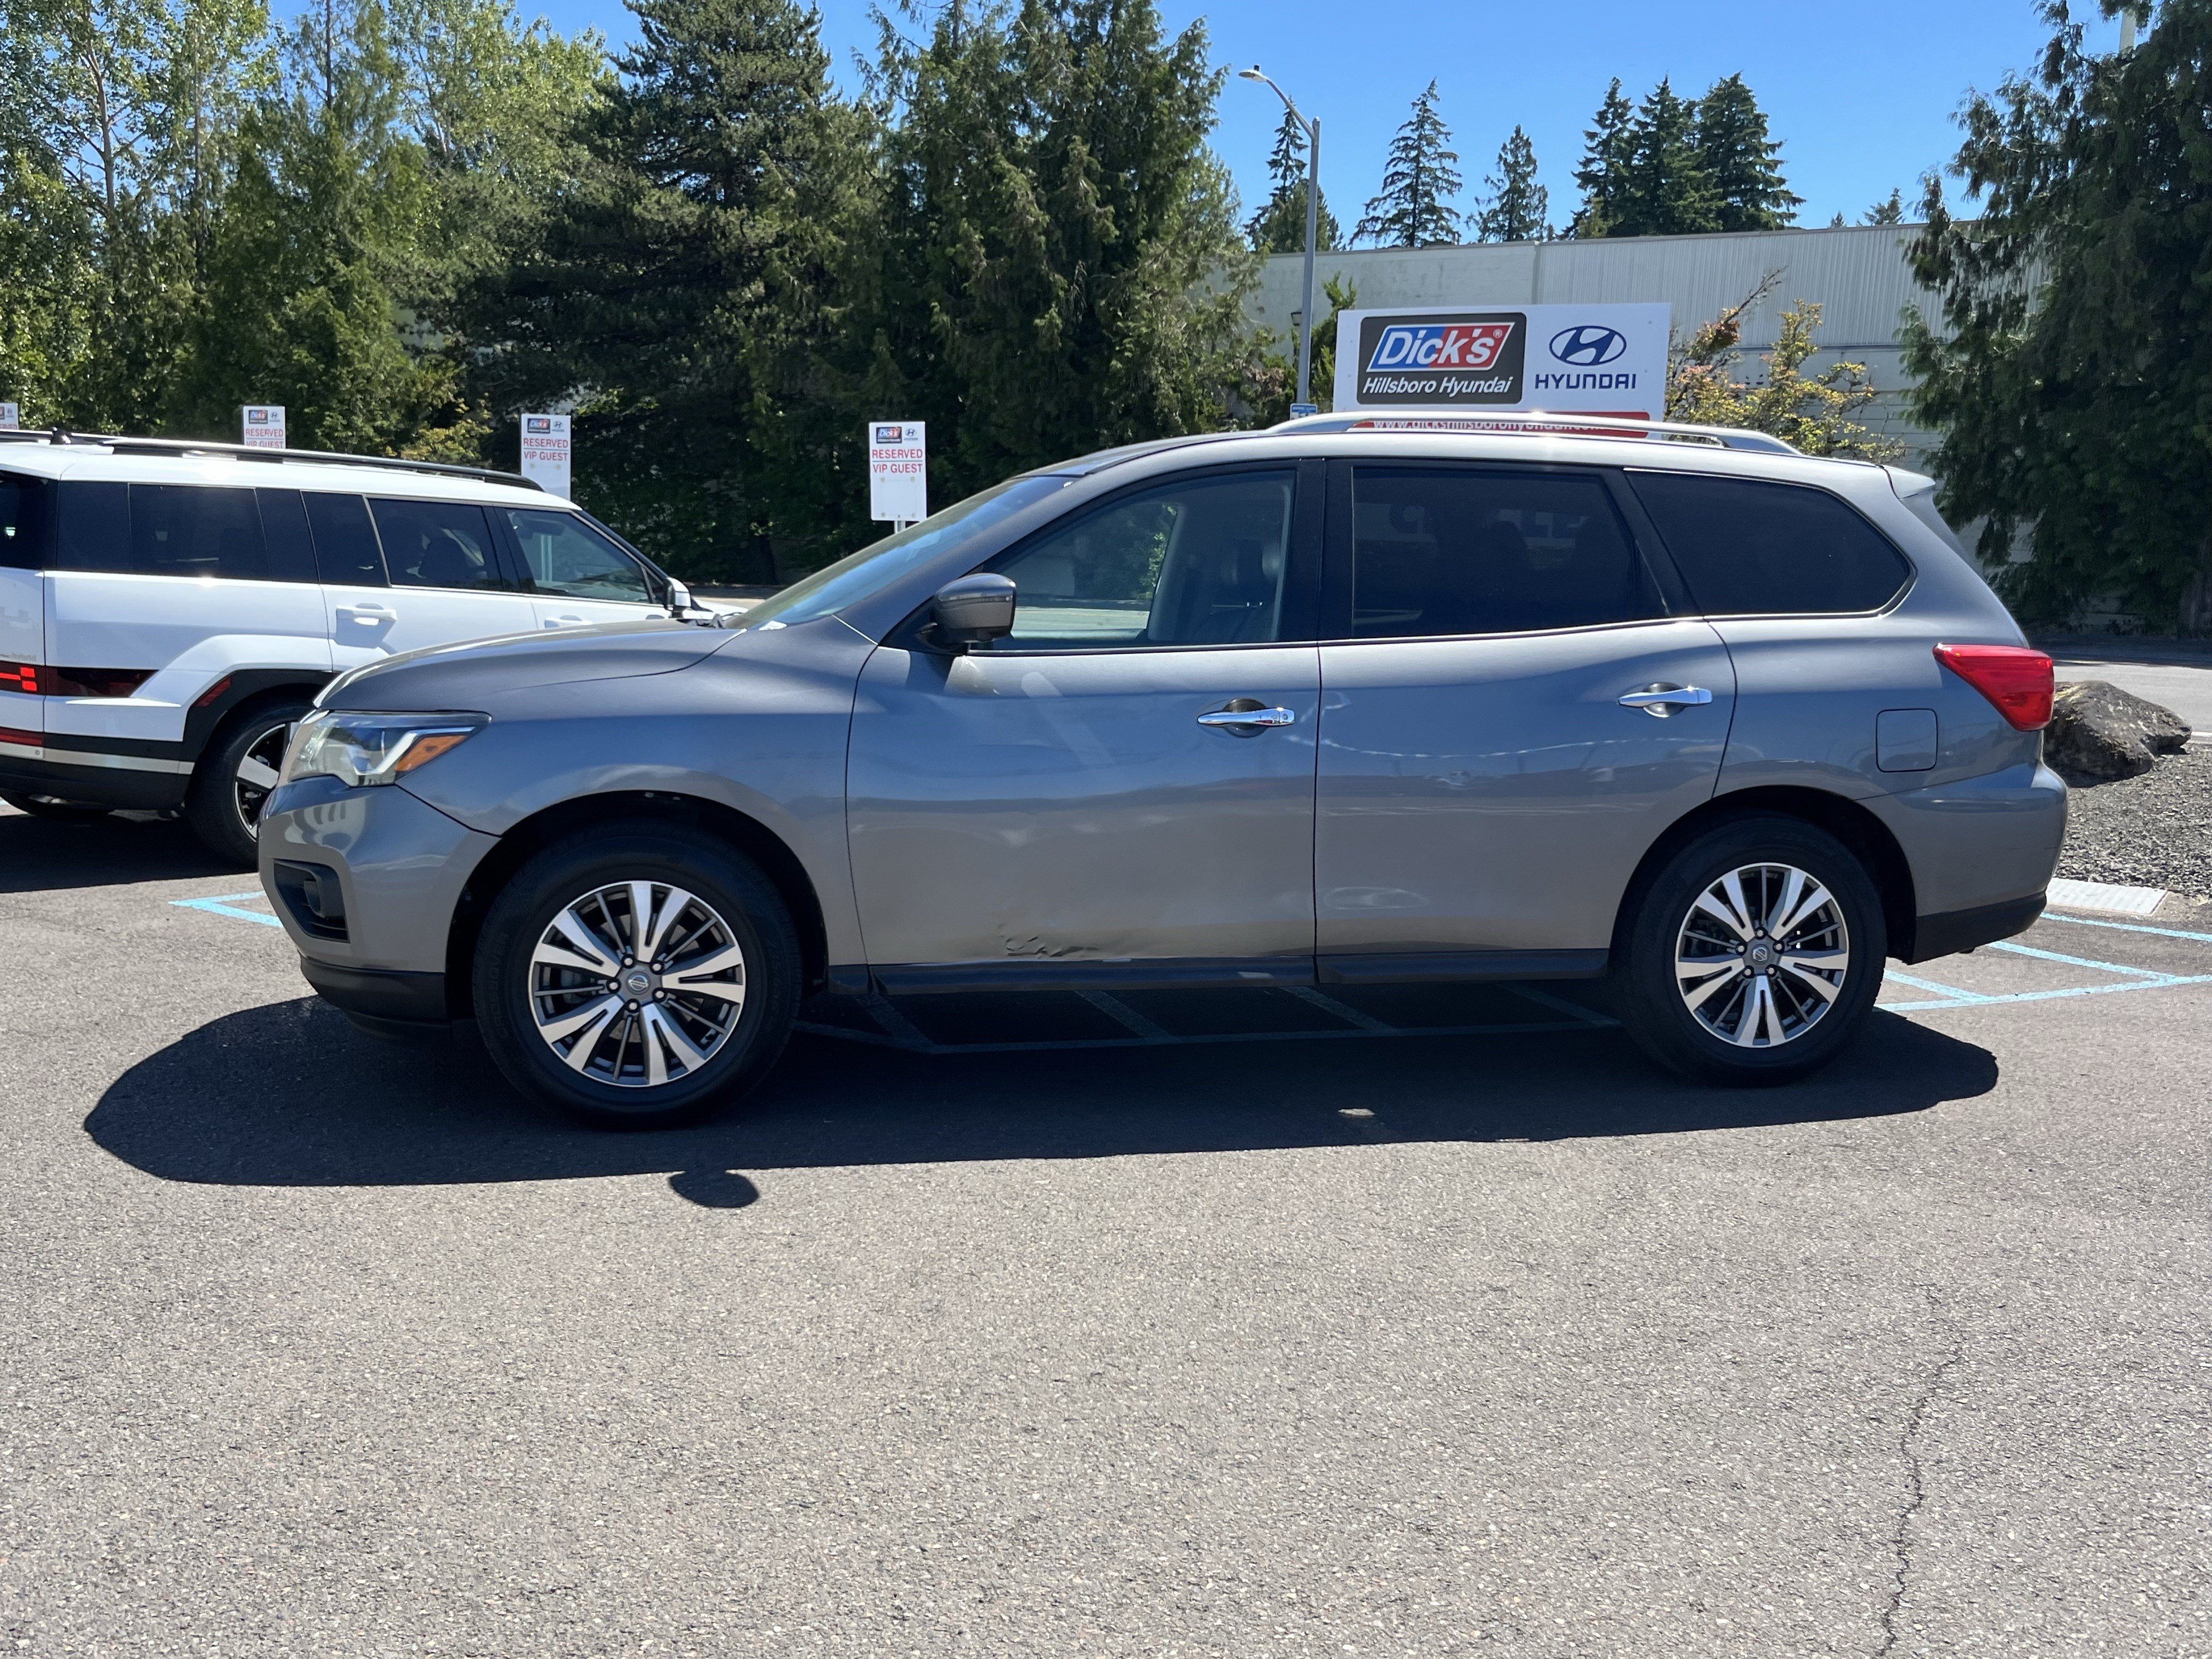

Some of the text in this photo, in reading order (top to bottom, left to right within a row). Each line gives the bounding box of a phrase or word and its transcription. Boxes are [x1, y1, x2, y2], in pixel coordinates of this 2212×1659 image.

[1535, 374, 1636, 389] HYUNDAI
[1363, 376, 1514, 398] Hillsboro Hyundai
[245, 428, 284, 437] RESERVED
[523, 438, 568, 448] RESERVED
[524, 451, 568, 461] VIP GUEST
[872, 449, 923, 459] RESERVED
[873, 464, 922, 473] VIP GUEST
